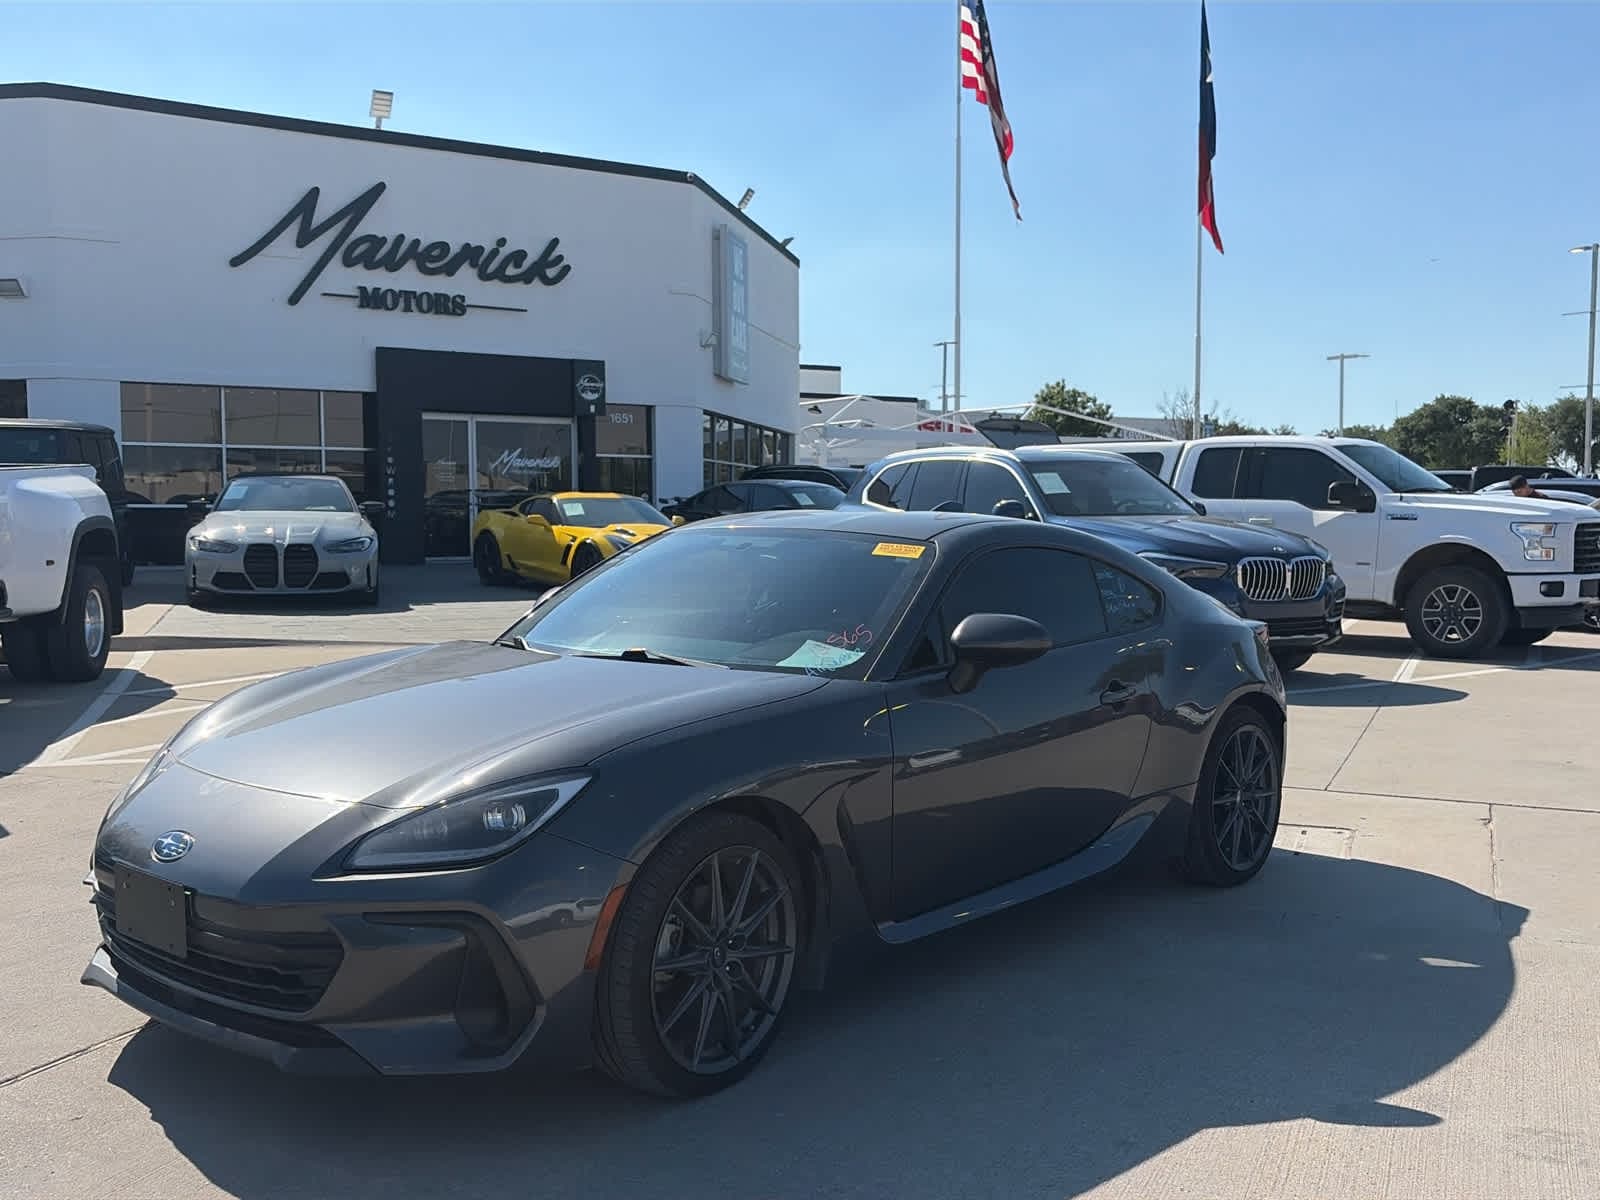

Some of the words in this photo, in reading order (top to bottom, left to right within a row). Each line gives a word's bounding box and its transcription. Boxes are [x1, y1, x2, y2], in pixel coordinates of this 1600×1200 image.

[229, 181, 572, 306] Maverick
[357, 286, 467, 316] MOTORS
[609, 412, 634, 425] 1651
[489, 447, 561, 475] Maverick
